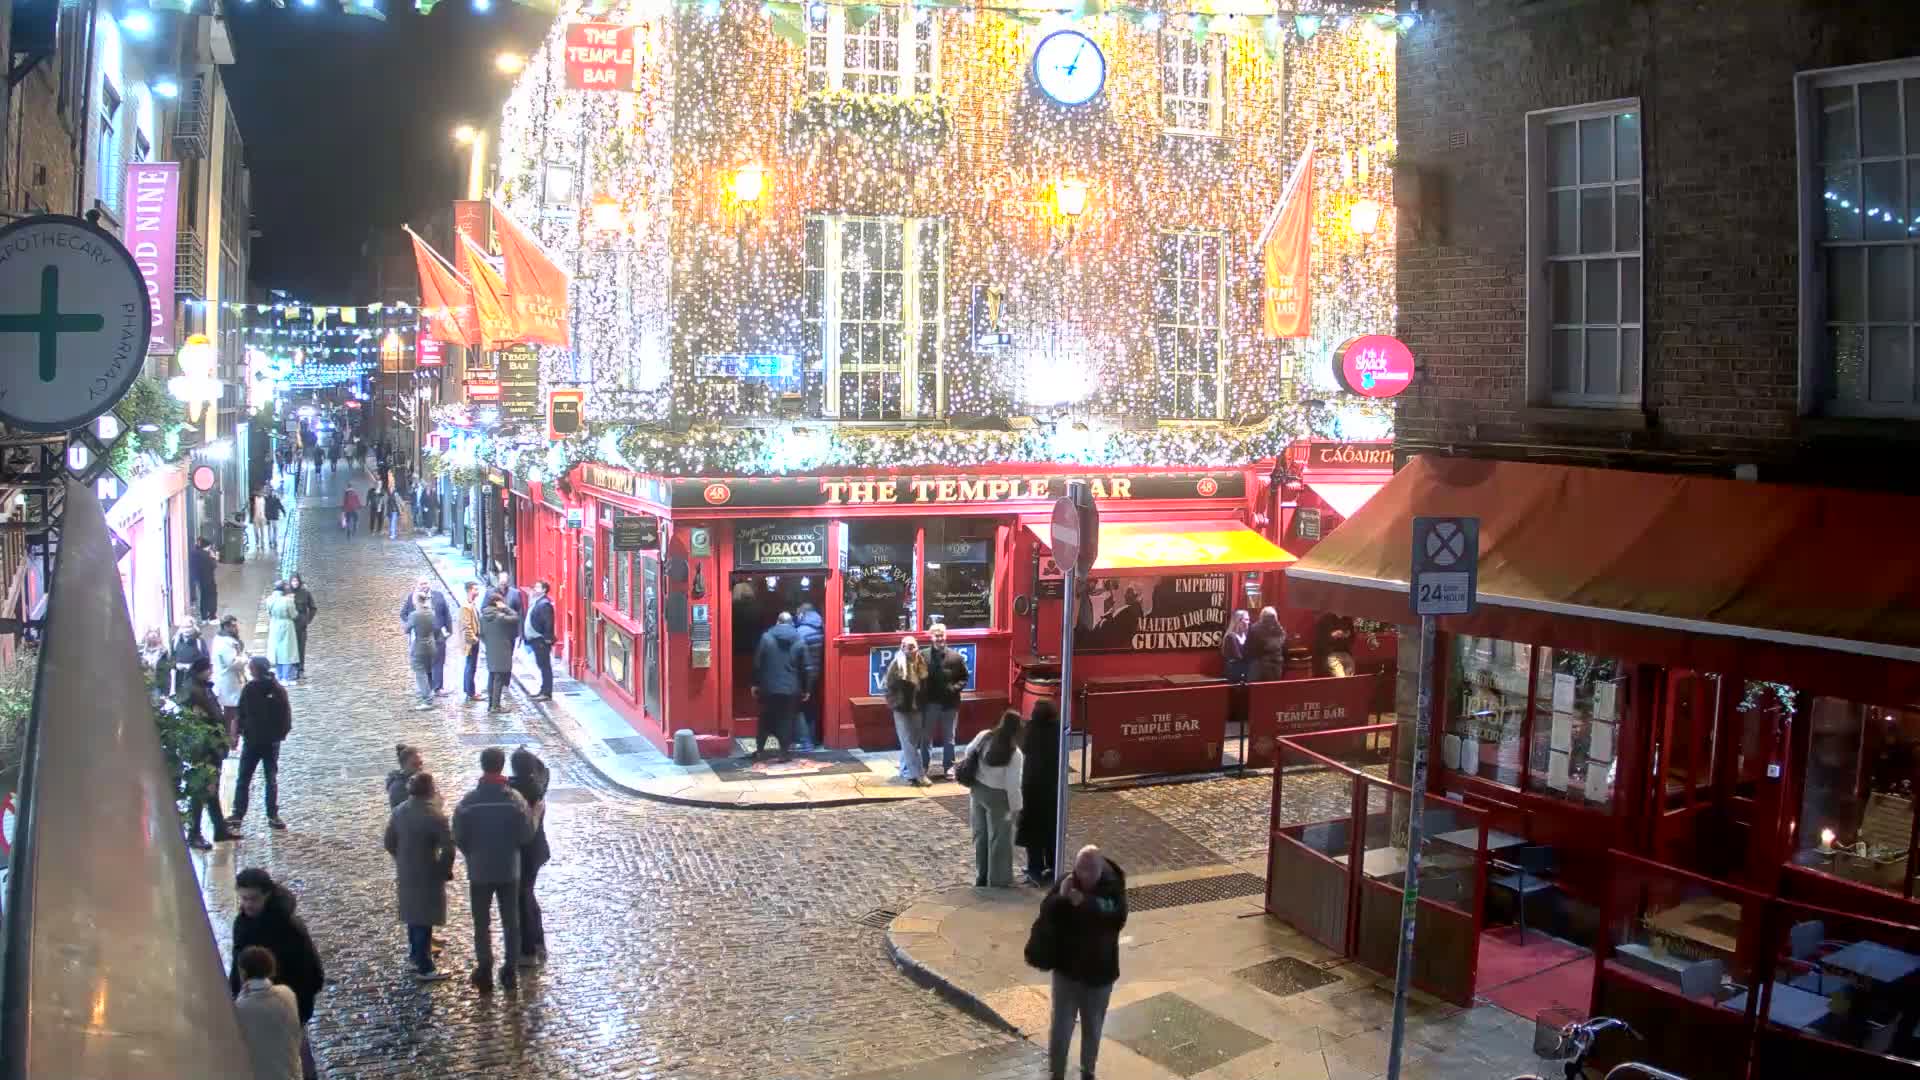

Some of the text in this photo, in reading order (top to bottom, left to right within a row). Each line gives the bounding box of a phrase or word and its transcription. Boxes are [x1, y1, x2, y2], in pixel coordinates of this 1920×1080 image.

[583, 28, 617, 45] THE
[567, 47, 633, 65] TEMPLE
[583, 68, 617, 84] BAR
[136, 170, 169, 232] NINE
[88, 302, 136, 401] PHARMACY
[823, 481, 897, 505] THE
[912, 478, 1050, 503] TEMPLE
[751, 538, 816, 561] TOBACCO
[1175, 577, 1225, 593] EMPEROR
[1420, 584, 1441, 602] 24
[1211, 592, 1225, 607] OF
[1138, 608, 1226, 632] MALTED LIQUORS
[1132, 631, 1224, 649] GUINNESS
[1152, 713, 1171, 722] THE
[1276, 707, 1345, 722] TEMPLE BAR
[1120, 720, 1200, 736] TEMPLE BAR
